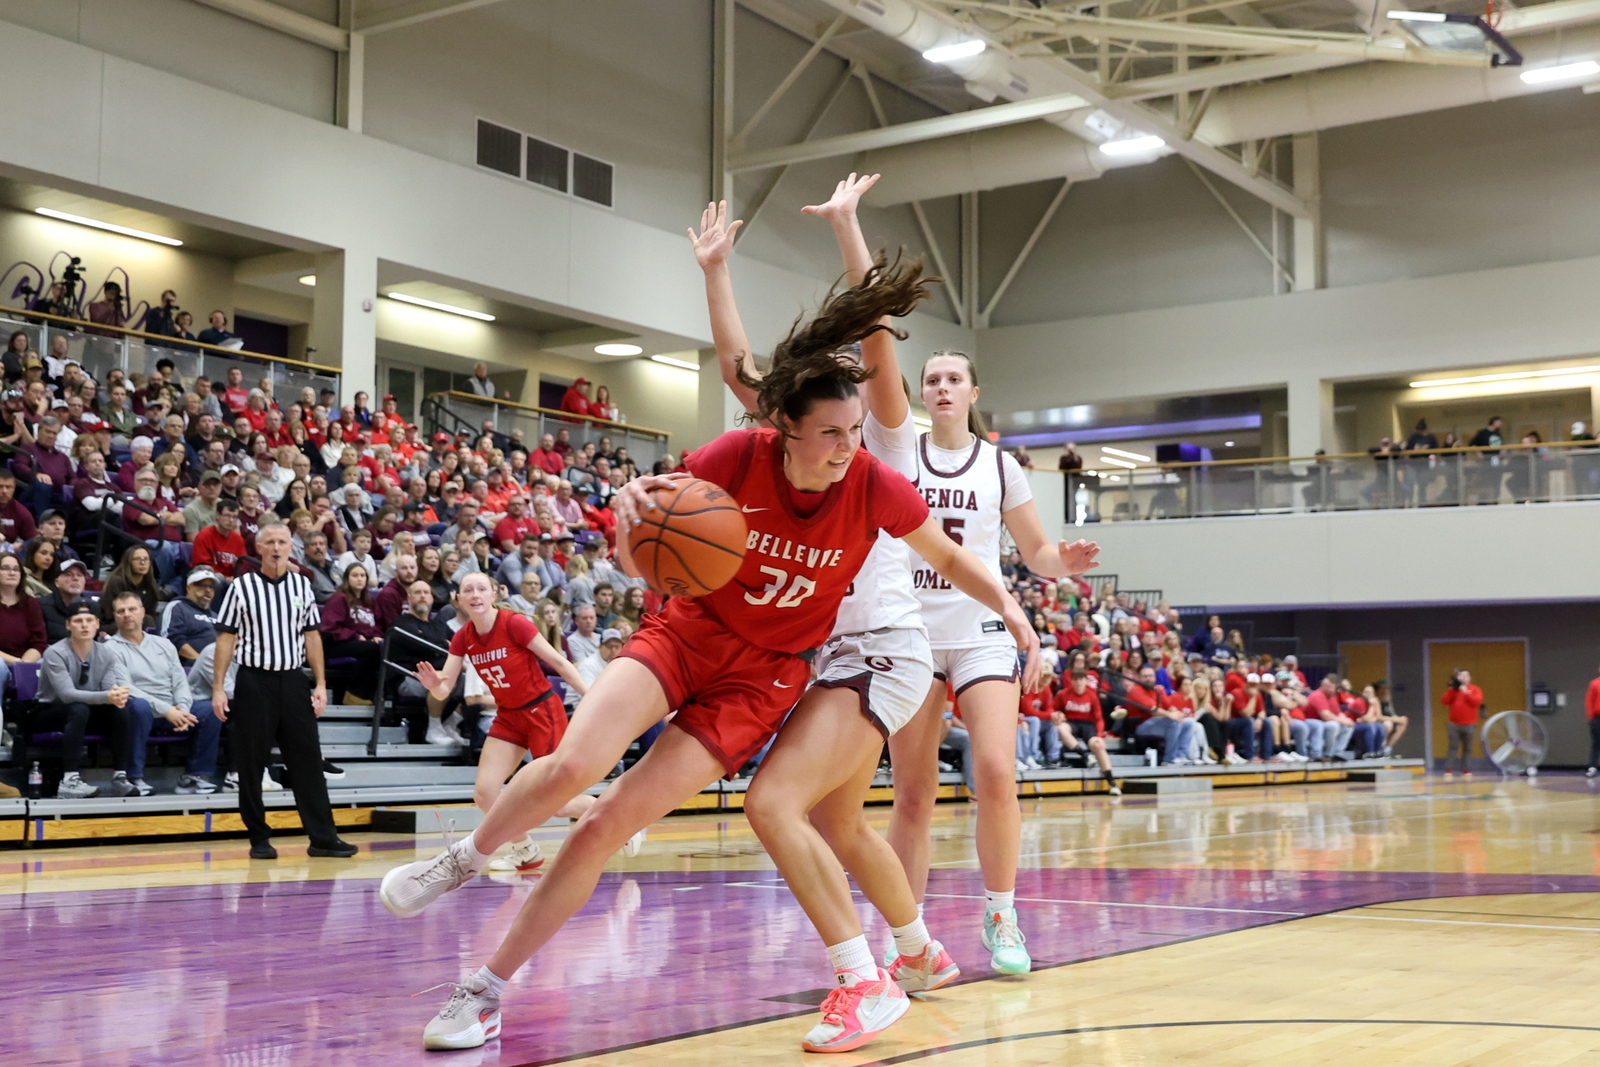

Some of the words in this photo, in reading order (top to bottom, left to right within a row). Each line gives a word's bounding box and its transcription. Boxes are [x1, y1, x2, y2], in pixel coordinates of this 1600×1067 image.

[743, 565, 817, 609] 30
[471, 647, 508, 665] BELLEVUE
[480, 665, 511, 689] 32
